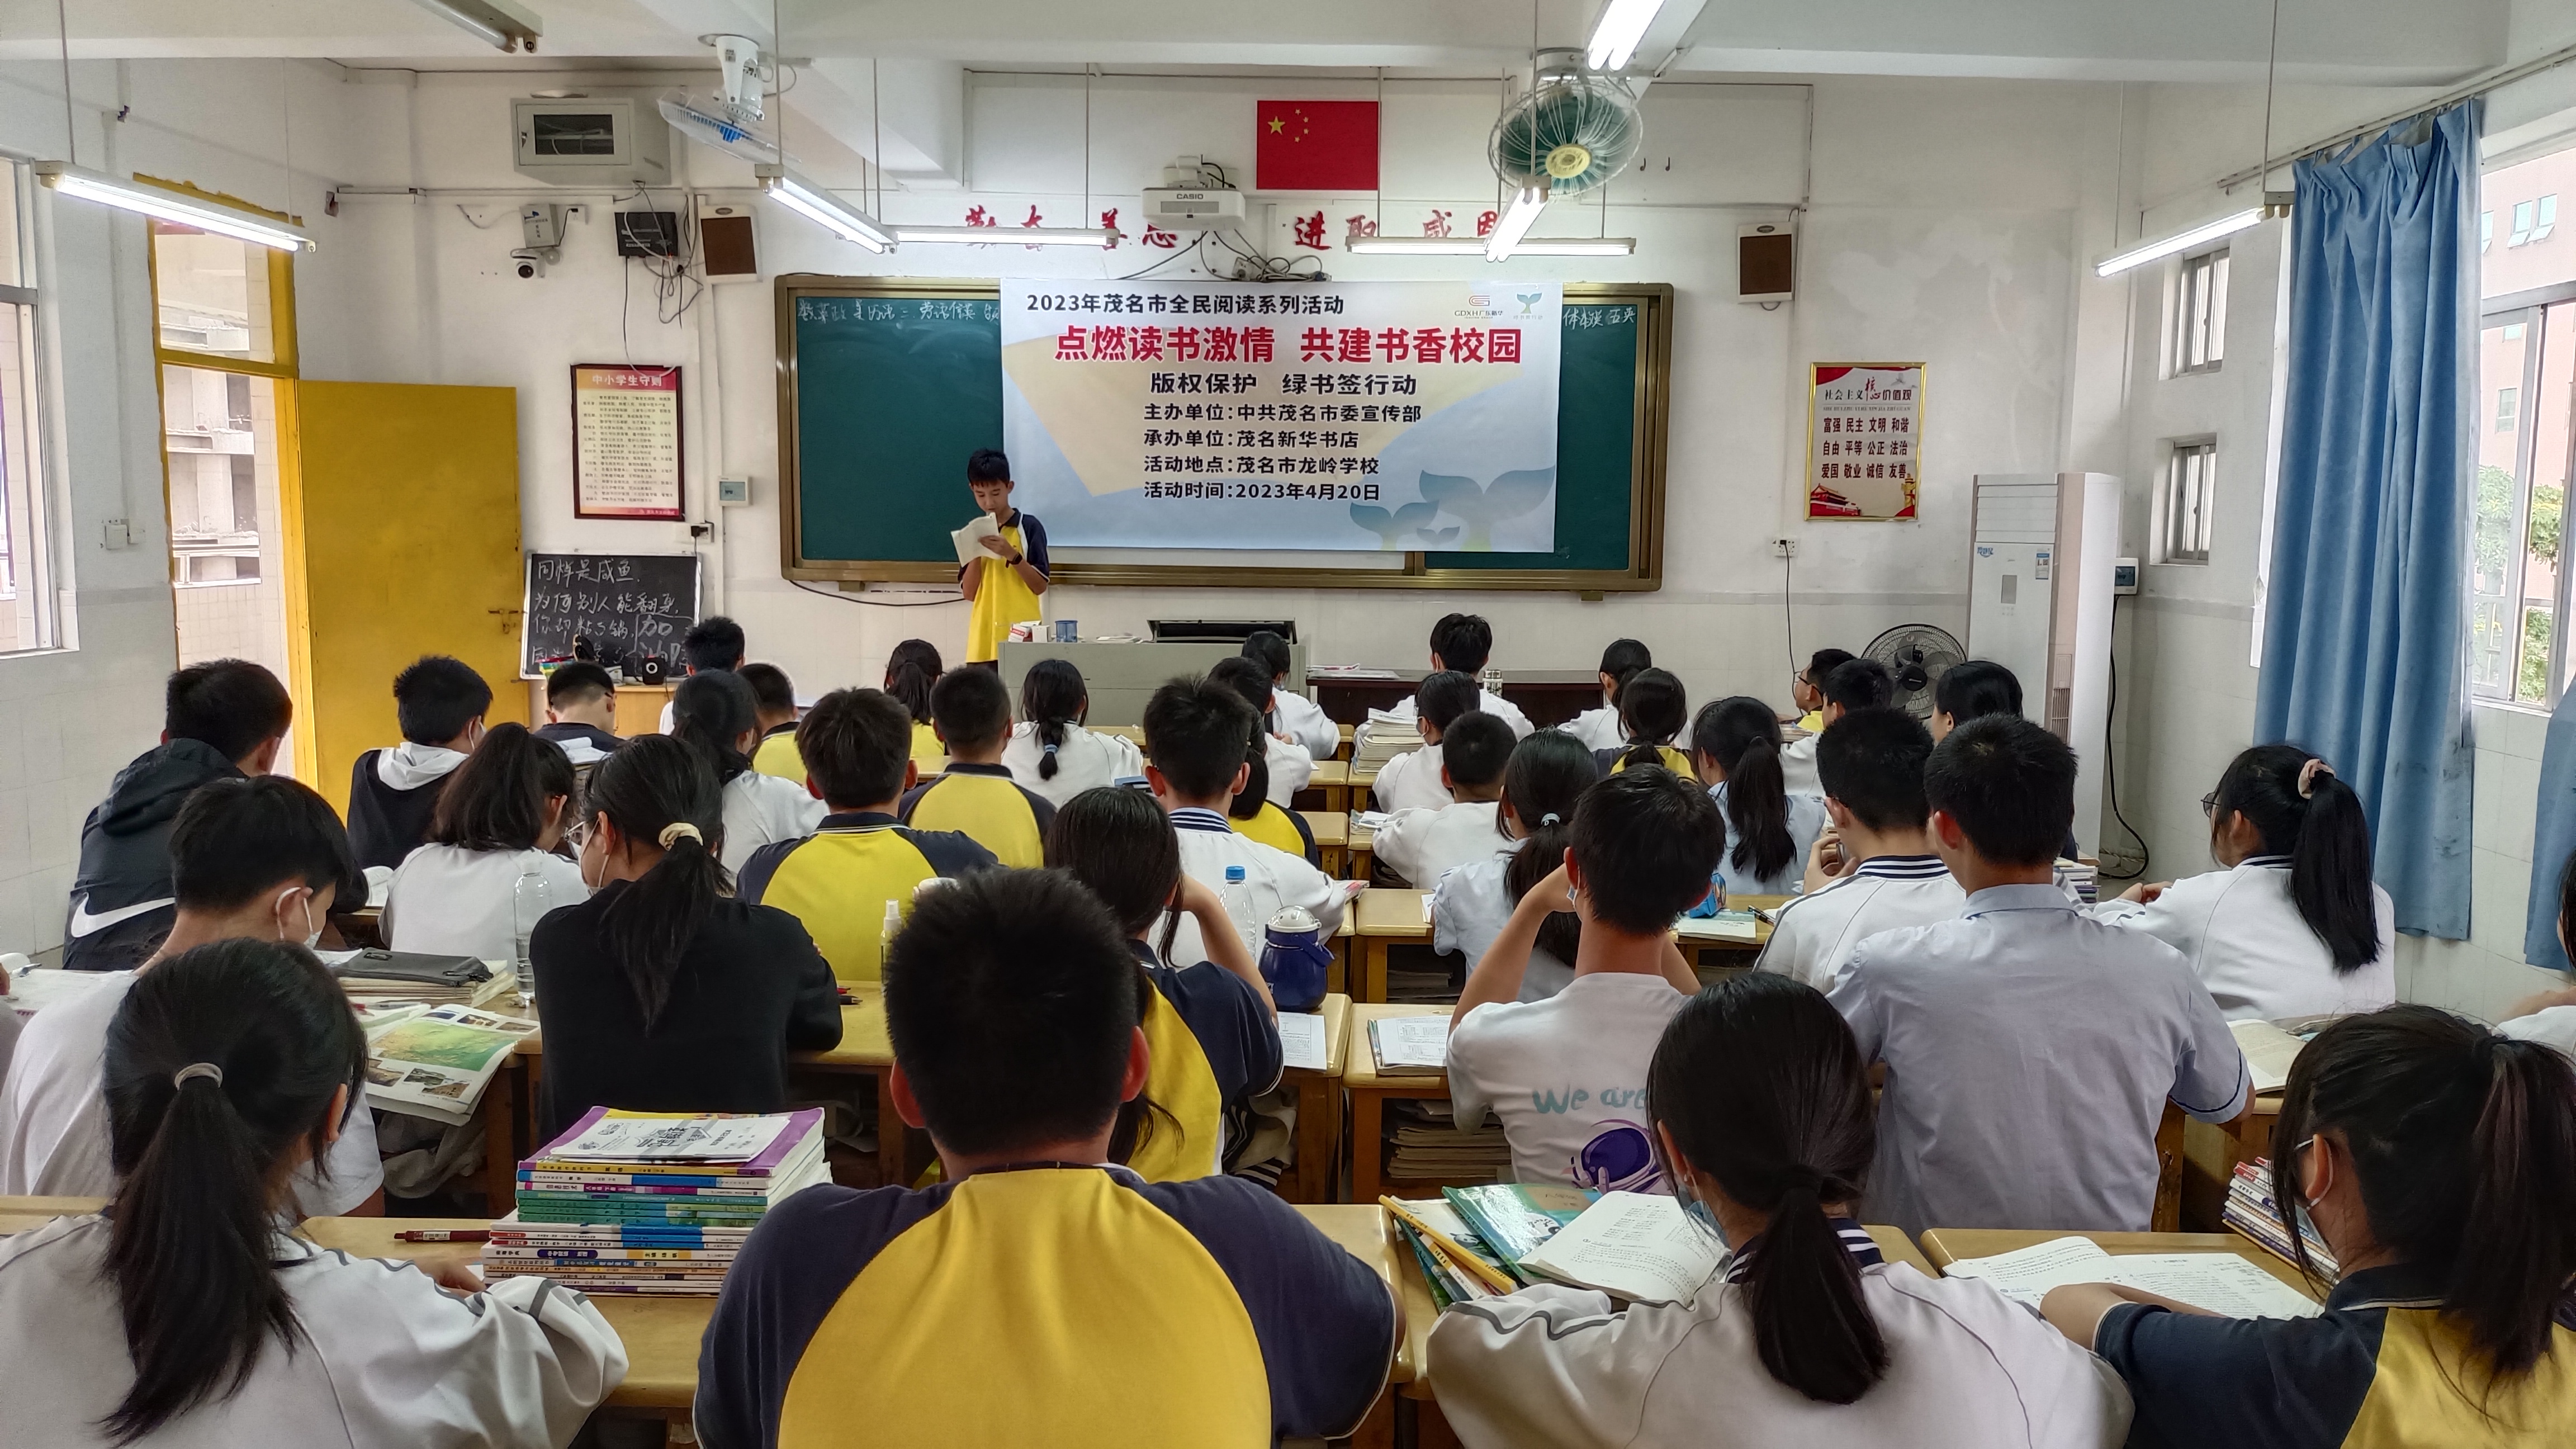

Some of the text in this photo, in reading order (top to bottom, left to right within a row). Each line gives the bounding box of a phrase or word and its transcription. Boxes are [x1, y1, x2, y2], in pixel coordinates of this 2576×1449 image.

[1027, 293, 1344, 315] 2023年茂名市全民阅读系列活动
[1055, 325, 1522, 364] 点燃读书激情 共建书香校园
[592, 375, 662, 386] 中小学生守则
[1150, 373, 1417, 396] 版权保护 绿书签行动
[1824, 418, 1909, 433] 富强 民主 文明 和谐
[1823, 440, 1908, 456] 自由 平等 公正 法治
[1821, 463, 1906, 479] 爱国 敬业 诚信 友善
[1532, 1083, 1646, 1114] We are
